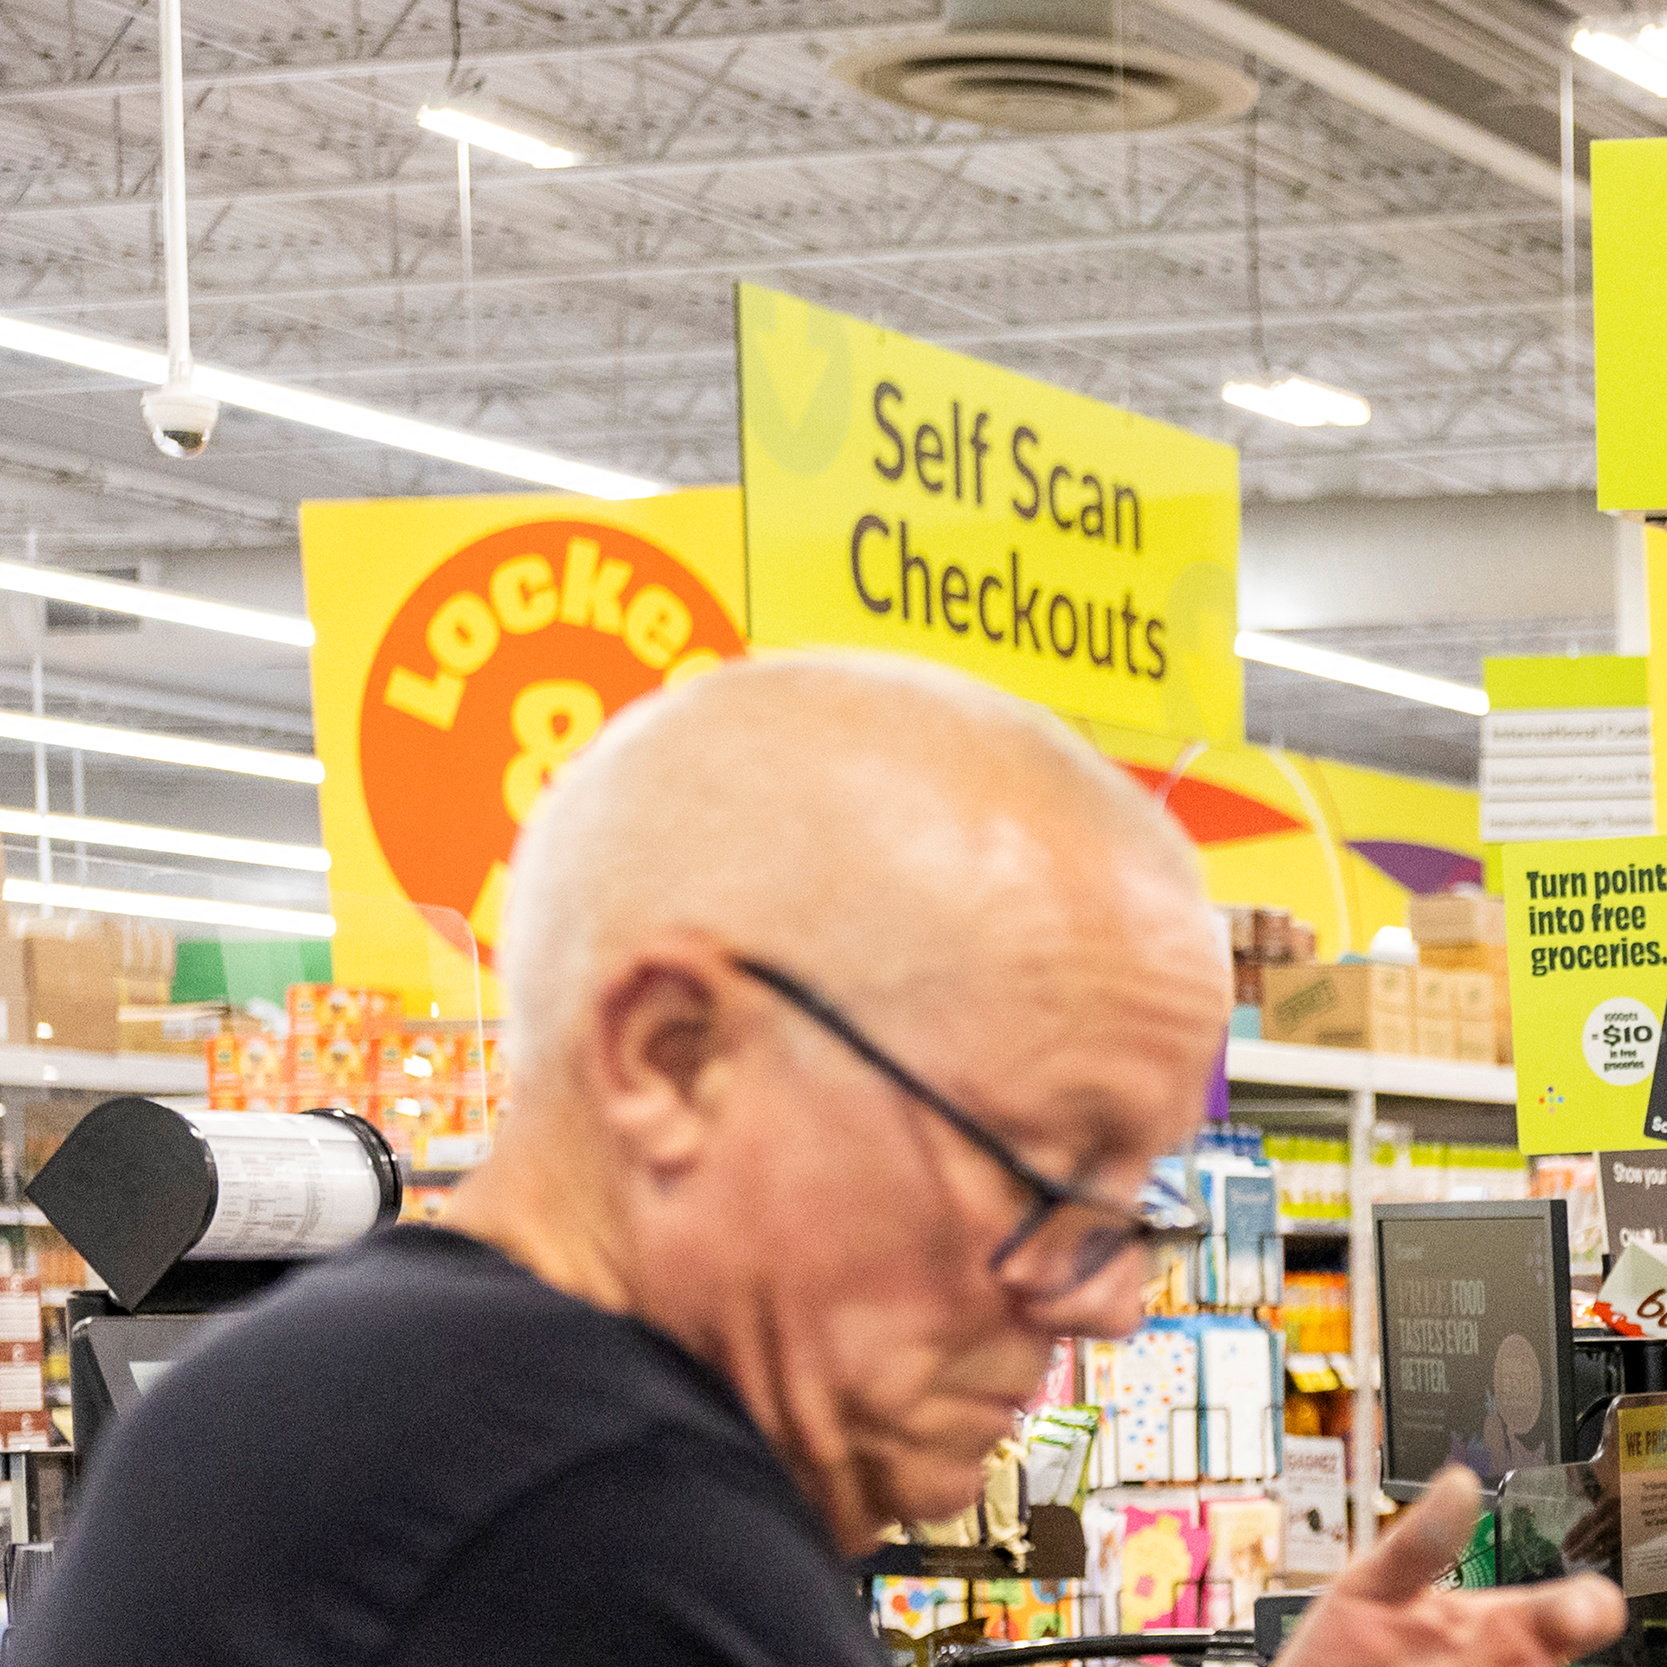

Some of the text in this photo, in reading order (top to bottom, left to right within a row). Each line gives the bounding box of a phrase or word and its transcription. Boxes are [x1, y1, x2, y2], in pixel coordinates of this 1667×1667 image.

[871, 380, 1145, 554] Self Scan
[849, 512, 1170, 685] Checkouts
[1526, 869, 1587, 900] Turn
[1528, 902, 1646, 937] into free
[1602, 1024, 1654, 1047] $10
[1612, 1161, 1644, 1184] Show
[1643, 1165, 1667, 1189] your
